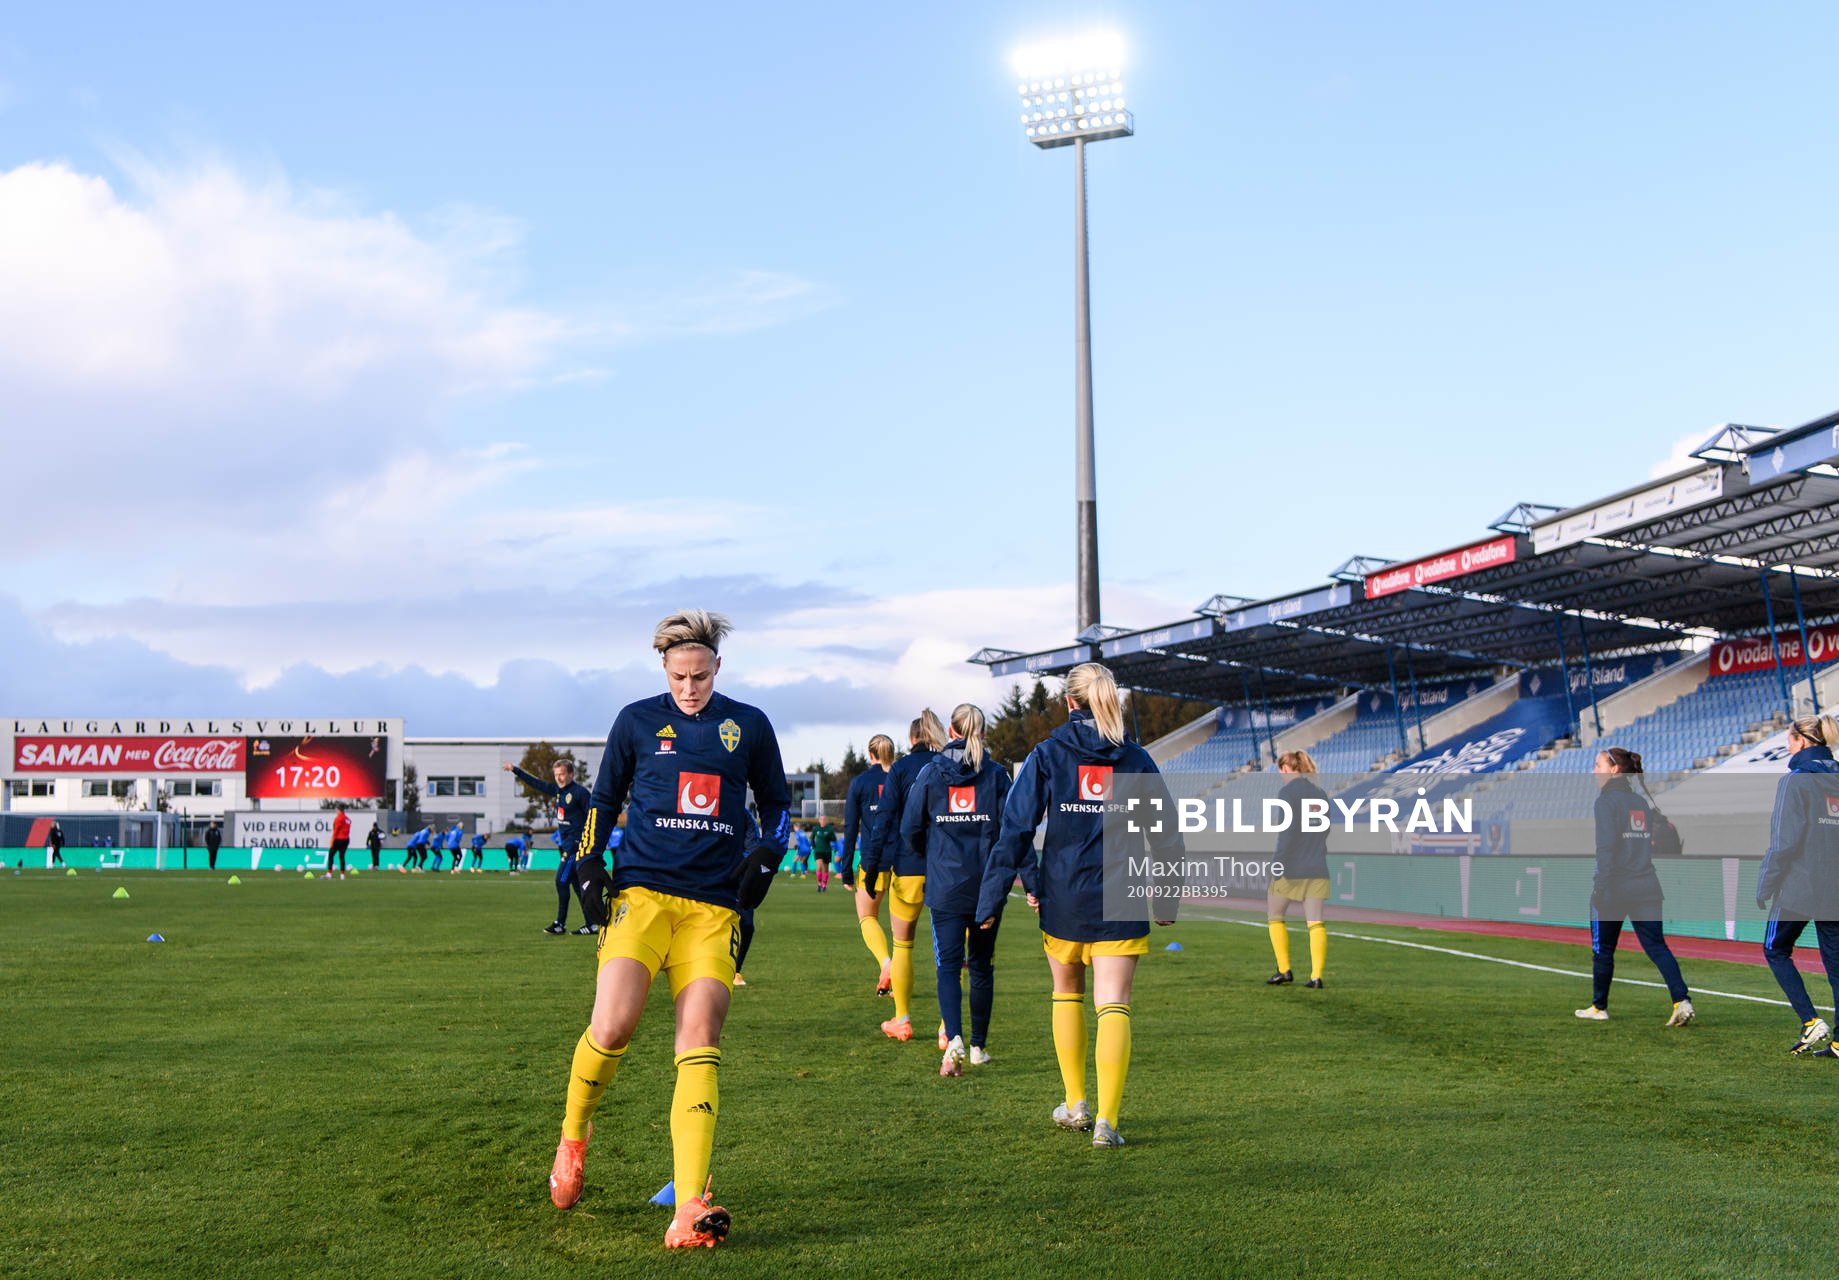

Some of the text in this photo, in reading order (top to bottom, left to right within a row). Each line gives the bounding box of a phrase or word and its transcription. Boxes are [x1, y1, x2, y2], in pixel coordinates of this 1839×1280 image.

[1736, 640, 1800, 665] vodafne
[18, 743, 123, 766] SAMAN
[275, 766, 341, 788] 17:20
[1060, 803, 1105, 814] SVENSKA
[270, 821, 310, 832] ERUM
[315, 818, 332, 832] ÖL
[936, 814, 991, 823] SVENSKA SPEL
[655, 818, 734, 836] SVENSKA SPEL
[250, 837, 290, 848] SAMA
